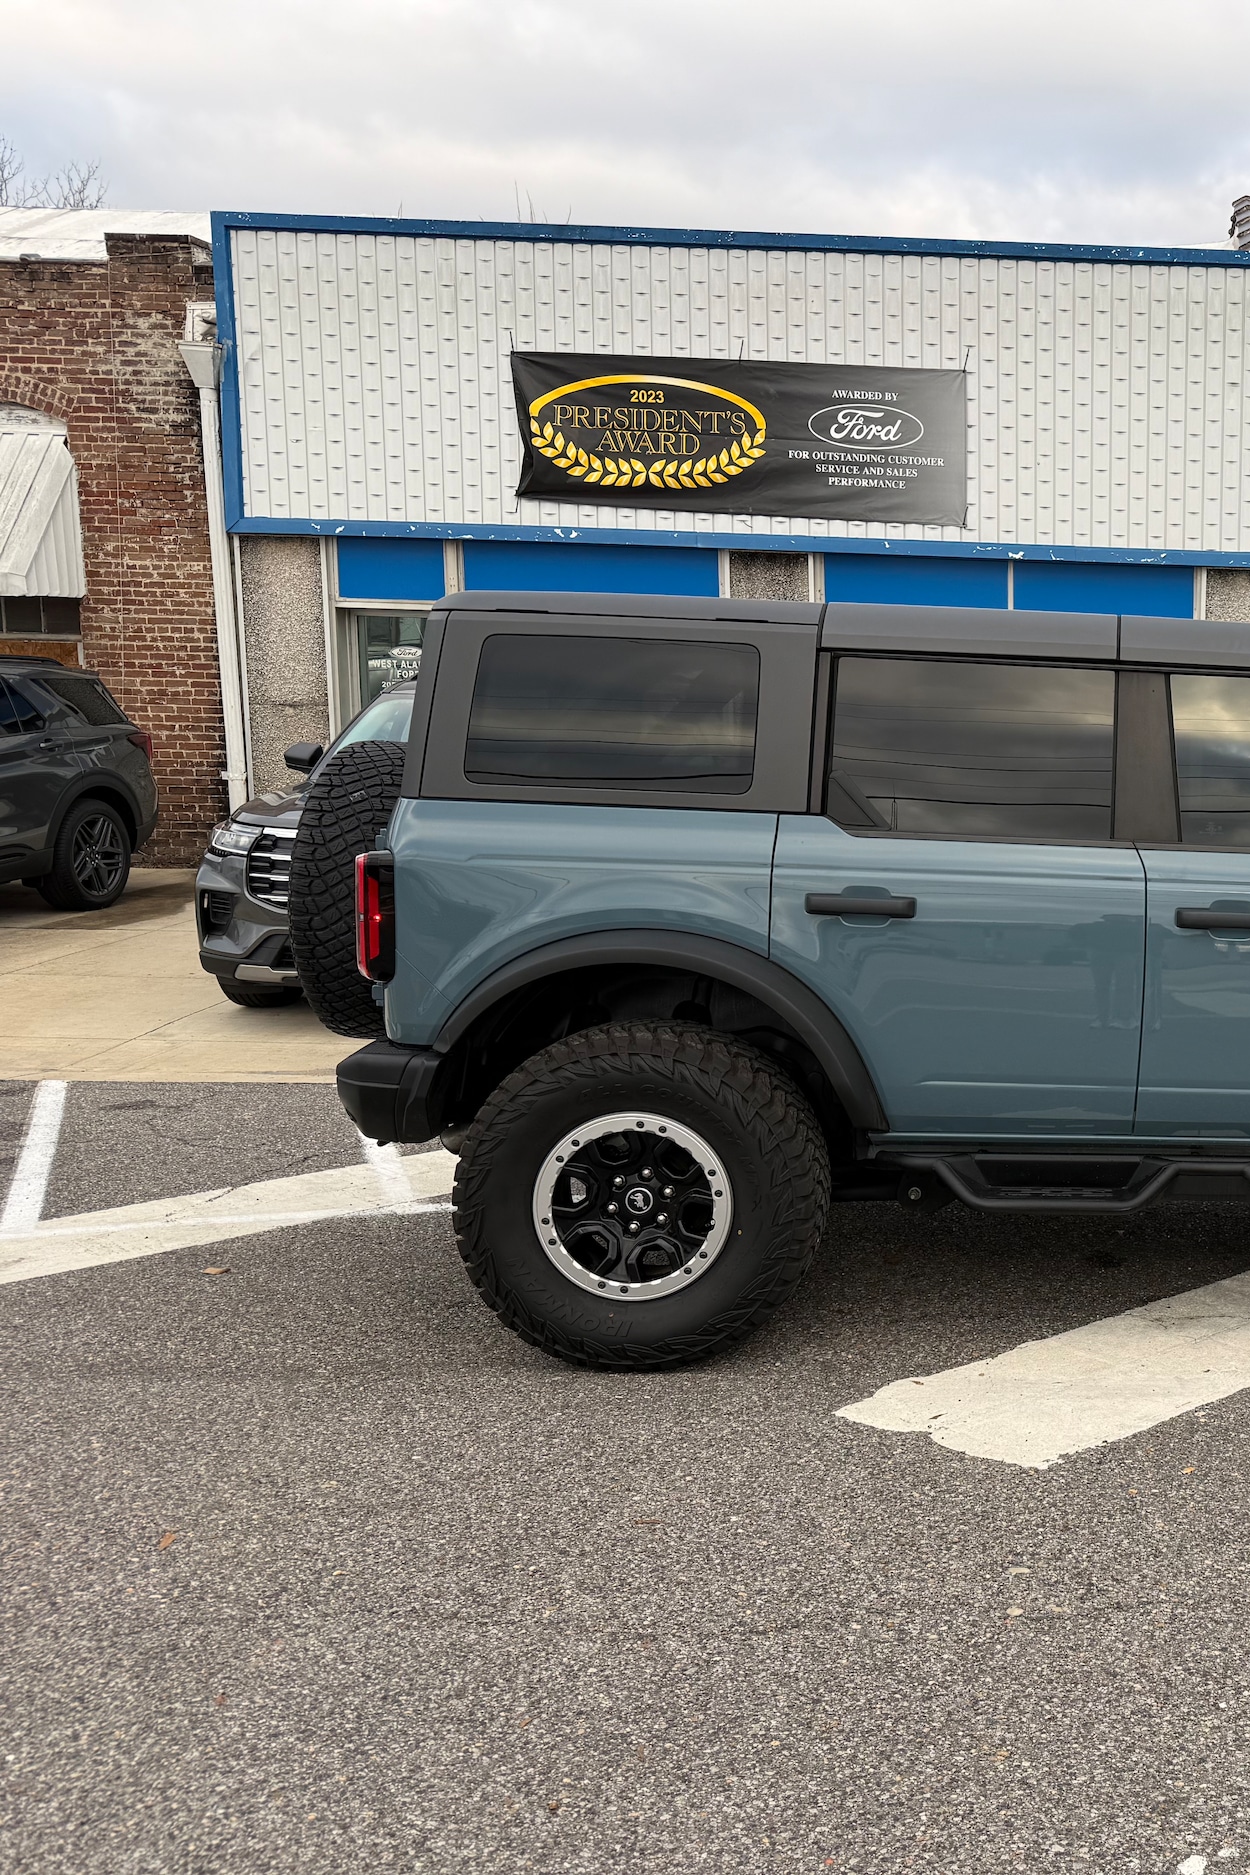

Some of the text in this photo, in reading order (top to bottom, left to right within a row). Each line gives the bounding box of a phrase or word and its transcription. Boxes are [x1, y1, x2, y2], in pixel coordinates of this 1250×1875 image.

[629, 389, 665, 403] 2023
[832, 389, 899, 401] AWARDED BY
[552, 404, 746, 435] PRESIDENT'S
[829, 409, 902, 441] Ford
[595, 430, 701, 456] AWARD
[788, 450, 945, 467] FOR OUTSTANDING CUSTOMER
[815, 464, 918, 478] SERVICE AND SALES
[828, 477, 906, 489] PERFORMANCE
[396, 648, 418, 657] Ford
[372, 659, 398, 668] WEST
